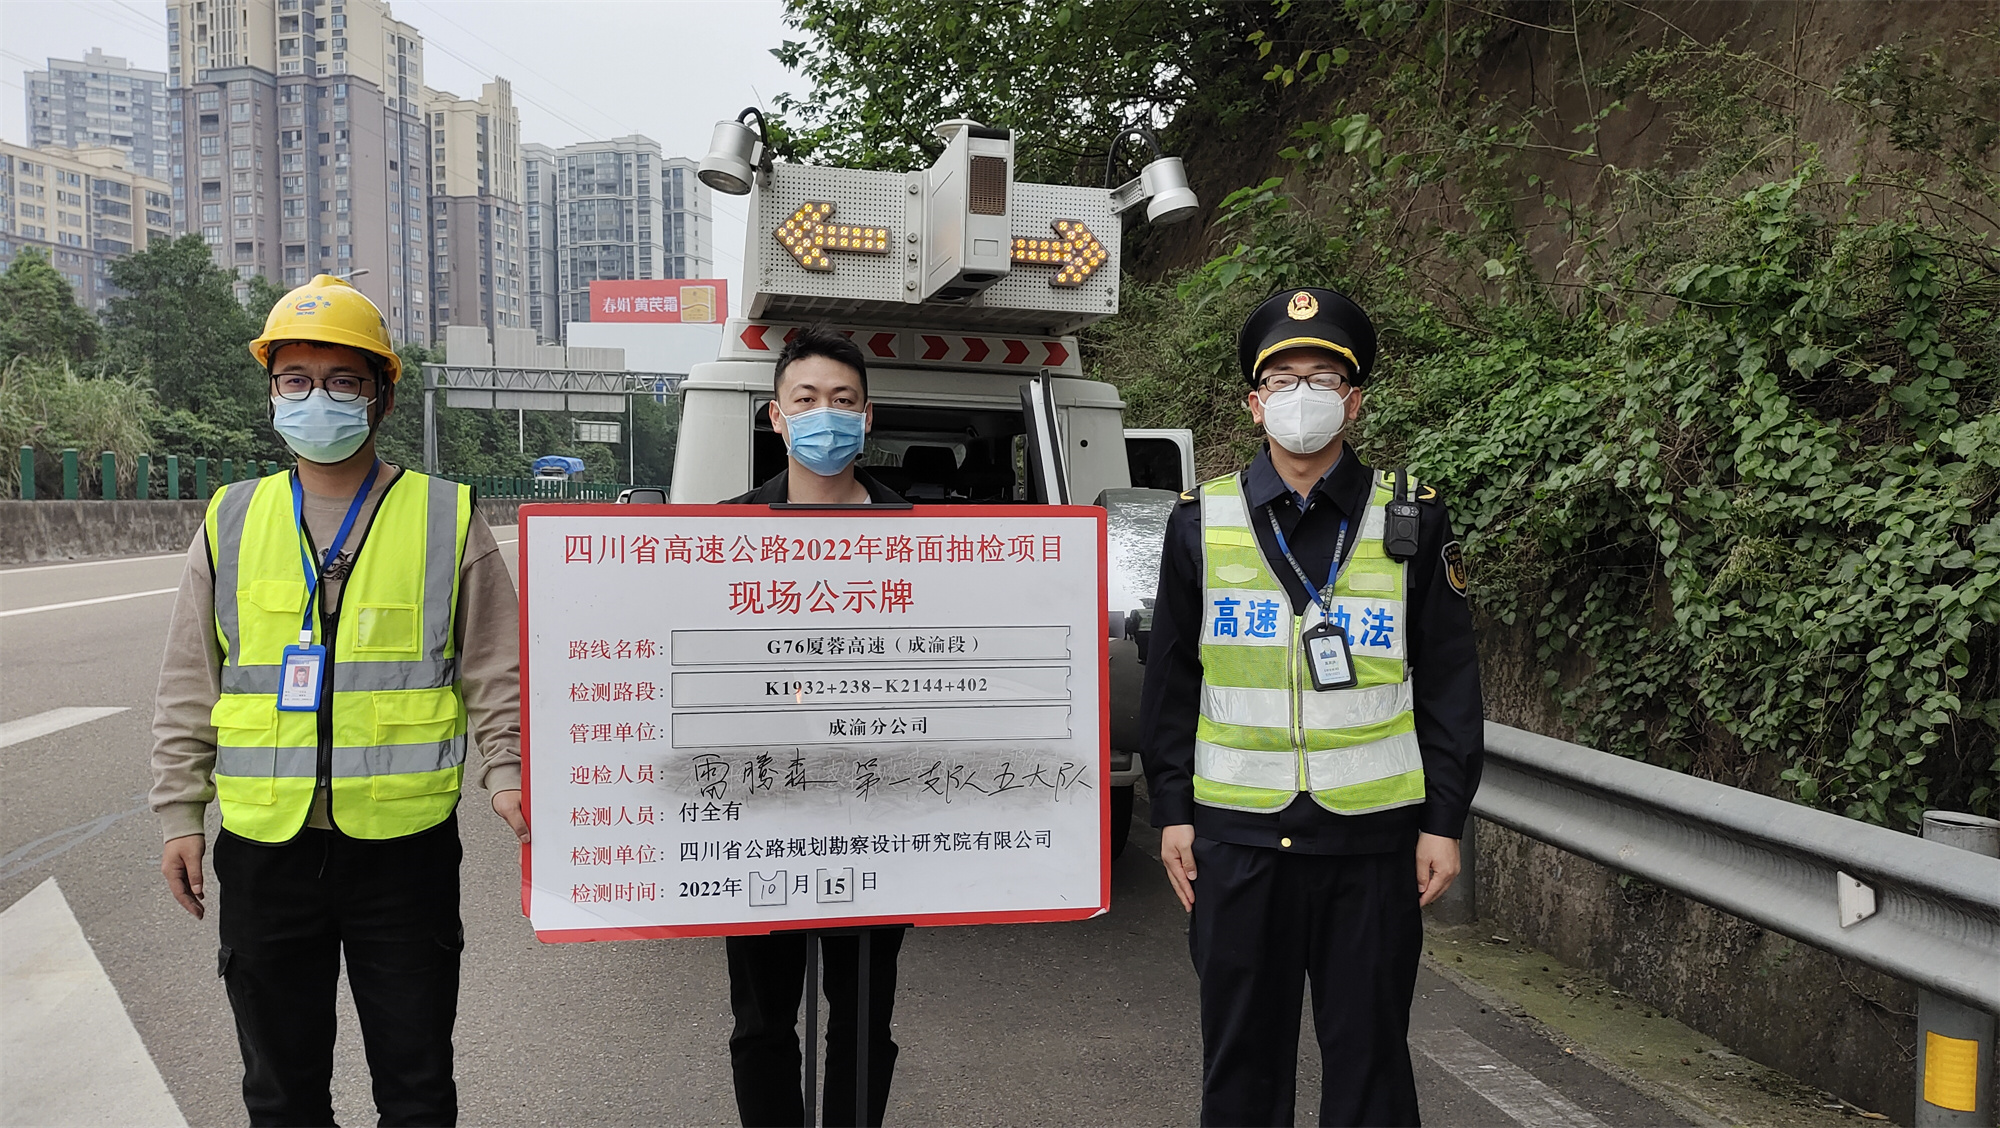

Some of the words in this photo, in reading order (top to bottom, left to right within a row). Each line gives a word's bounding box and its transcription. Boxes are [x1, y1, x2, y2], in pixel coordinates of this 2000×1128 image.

[563, 533, 1063, 566] 四川省高速公路2022年路面抽检项目
[728, 578, 916, 617] 现场公示牌
[1213, 596, 1280, 639] 高速
[568, 638, 664, 660] 路线名称：
[568, 681, 664, 703] 检测路段：
[764, 677, 989, 696] K1932+238-K2144+402
[568, 722, 664, 744] 管理单位：
[828, 716, 928, 737] 成渝分公司
[569, 763, 664, 785] 迎检人员：
[569, 805, 664, 827] 检测人员：
[678, 800, 743, 823] 付全有
[569, 844, 664, 867] 检测单位：
[679, 829, 1053, 863] 四川省公路规划勘察设计研究院有限公司
[569, 882, 664, 904] 检测时间：
